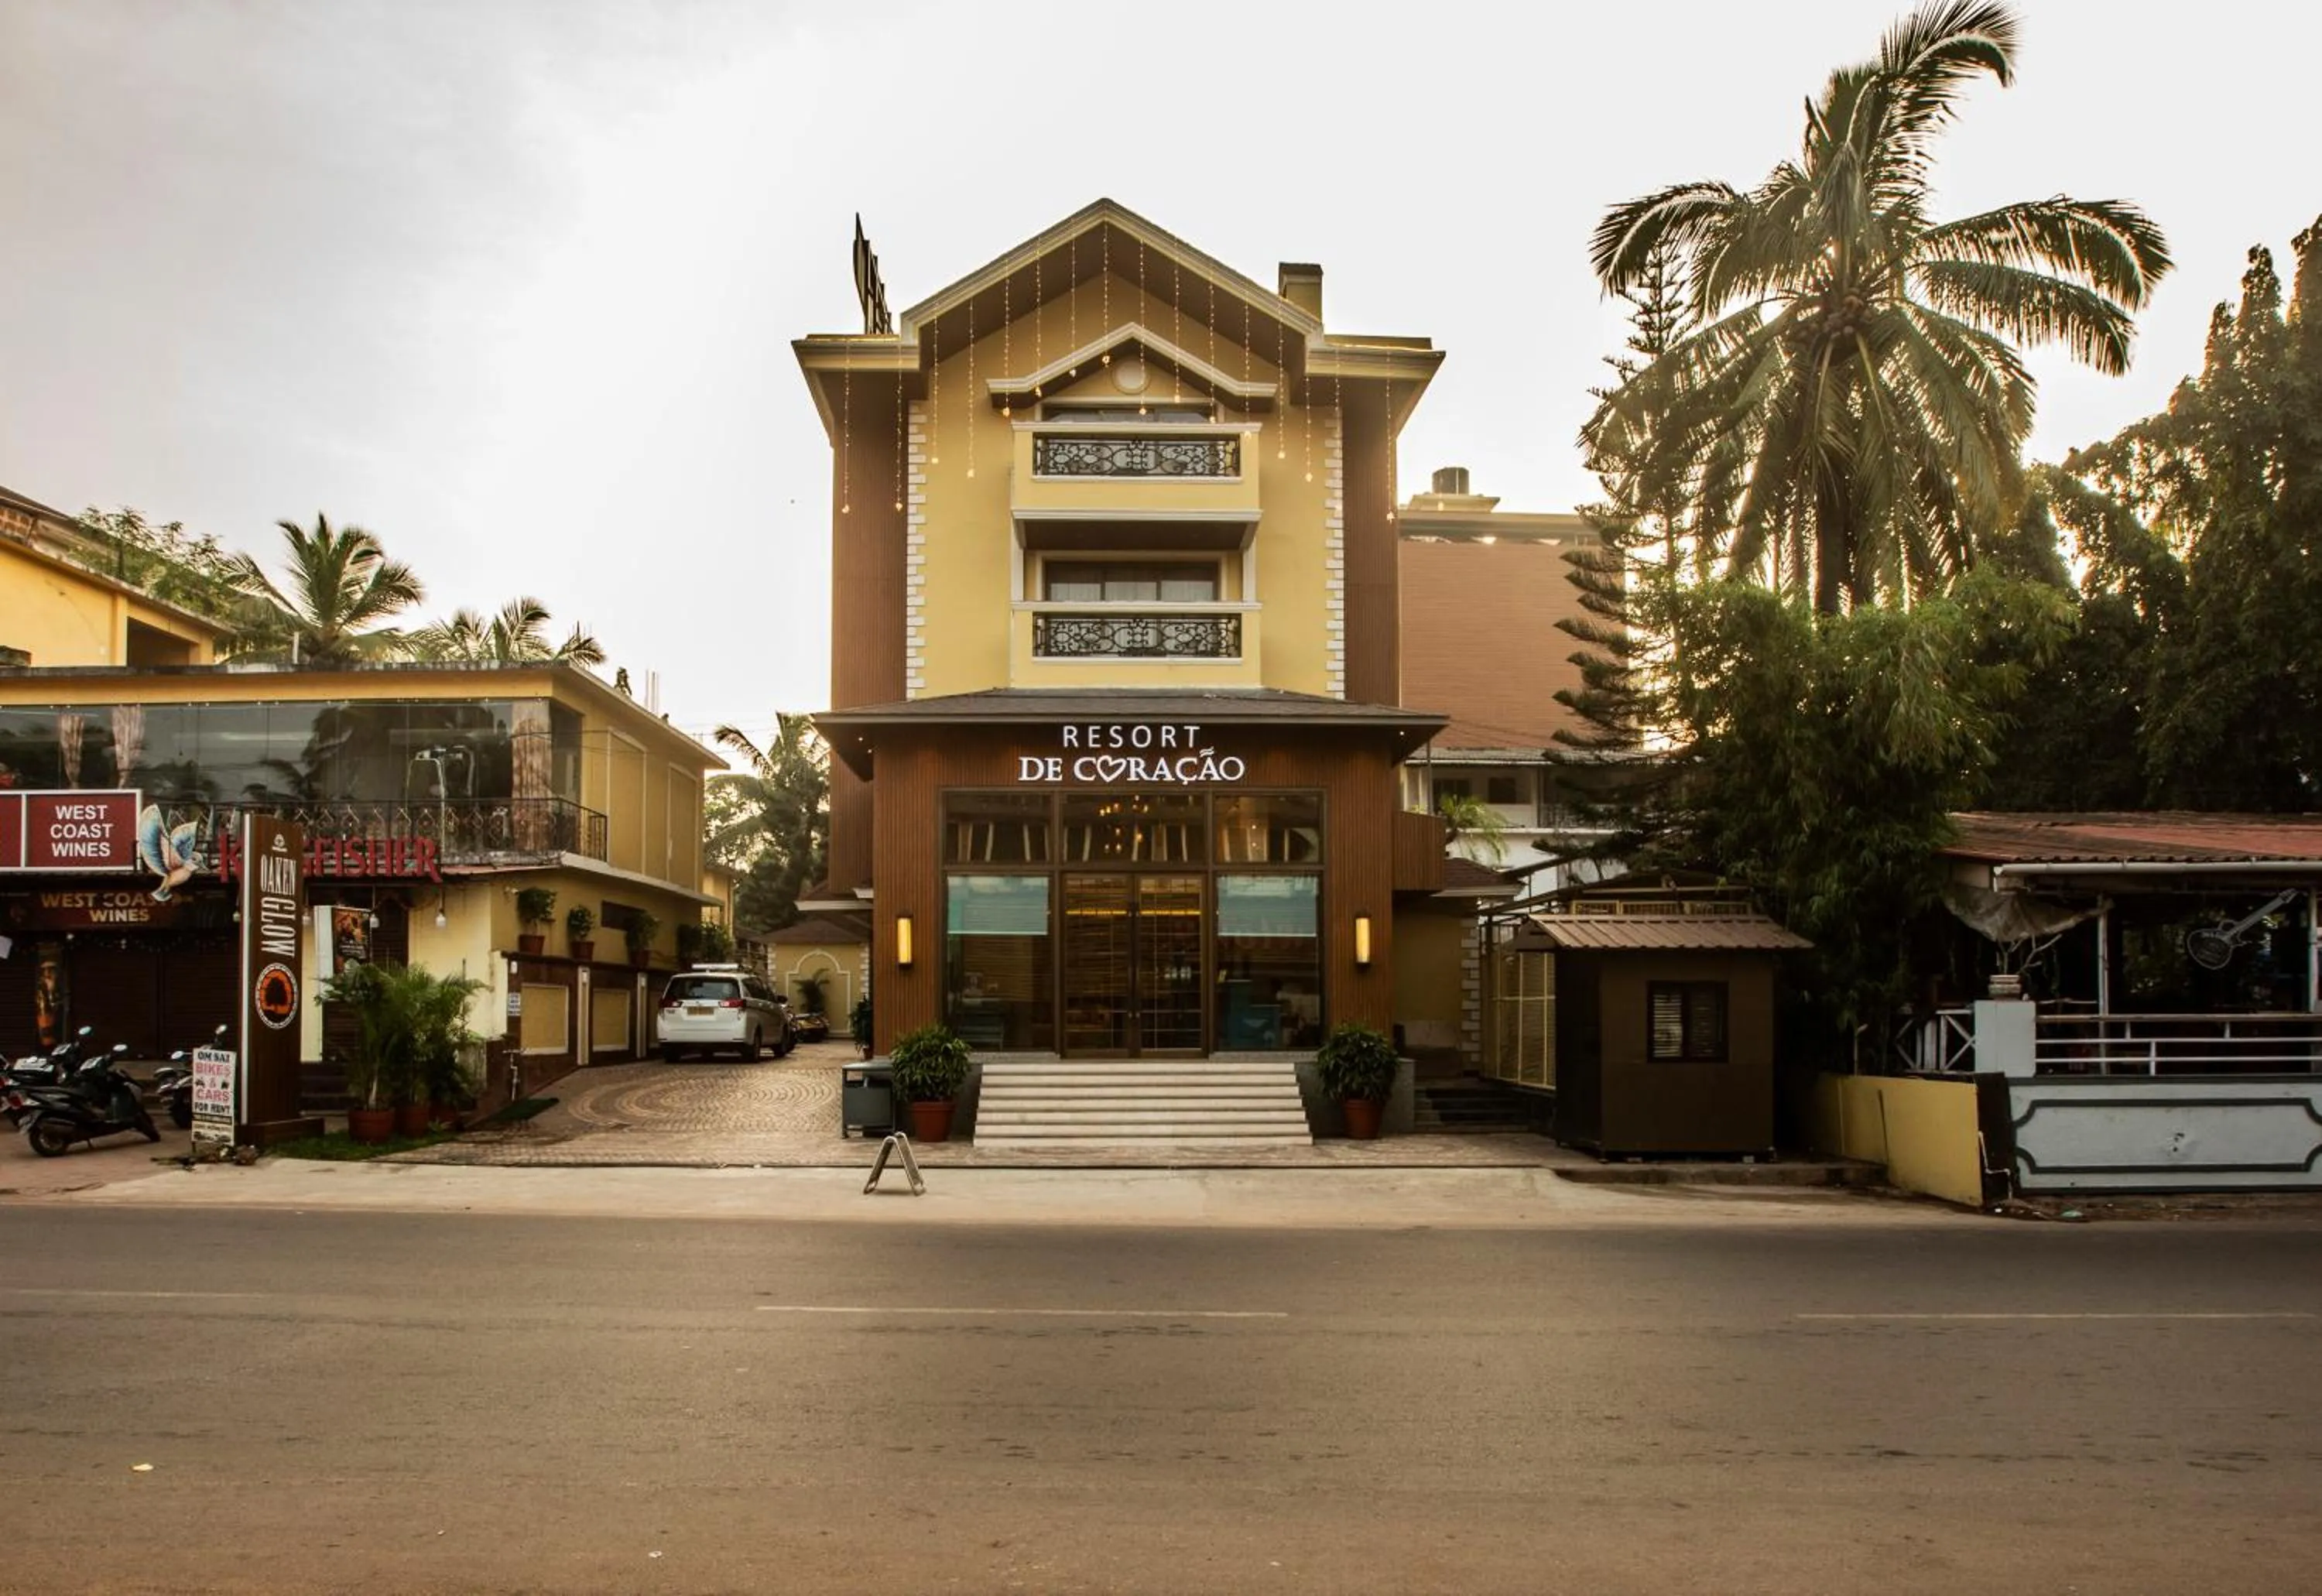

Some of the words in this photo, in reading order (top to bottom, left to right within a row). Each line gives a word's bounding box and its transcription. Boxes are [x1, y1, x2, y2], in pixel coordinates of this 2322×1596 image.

[1062, 725, 1200, 748] RESORT
[1018, 756, 1063, 781] DE
[55, 805, 108, 820] WEST
[50, 824, 114, 838] COAST
[51, 842, 111, 857] WINES
[218, 832, 443, 883] KFISHER
[260, 854, 296, 896] OAKEN
[41, 892, 96, 908] WEST
[90, 909, 149, 923] WINES
[260, 896, 296, 957] GLOW
[197, 1052, 211, 1060] OM
[195, 1063, 231, 1077] BIKES
[197, 1089, 230, 1102] CARS
[194, 1102, 208, 1111] FOR
[211, 1105, 231, 1114] RENT
